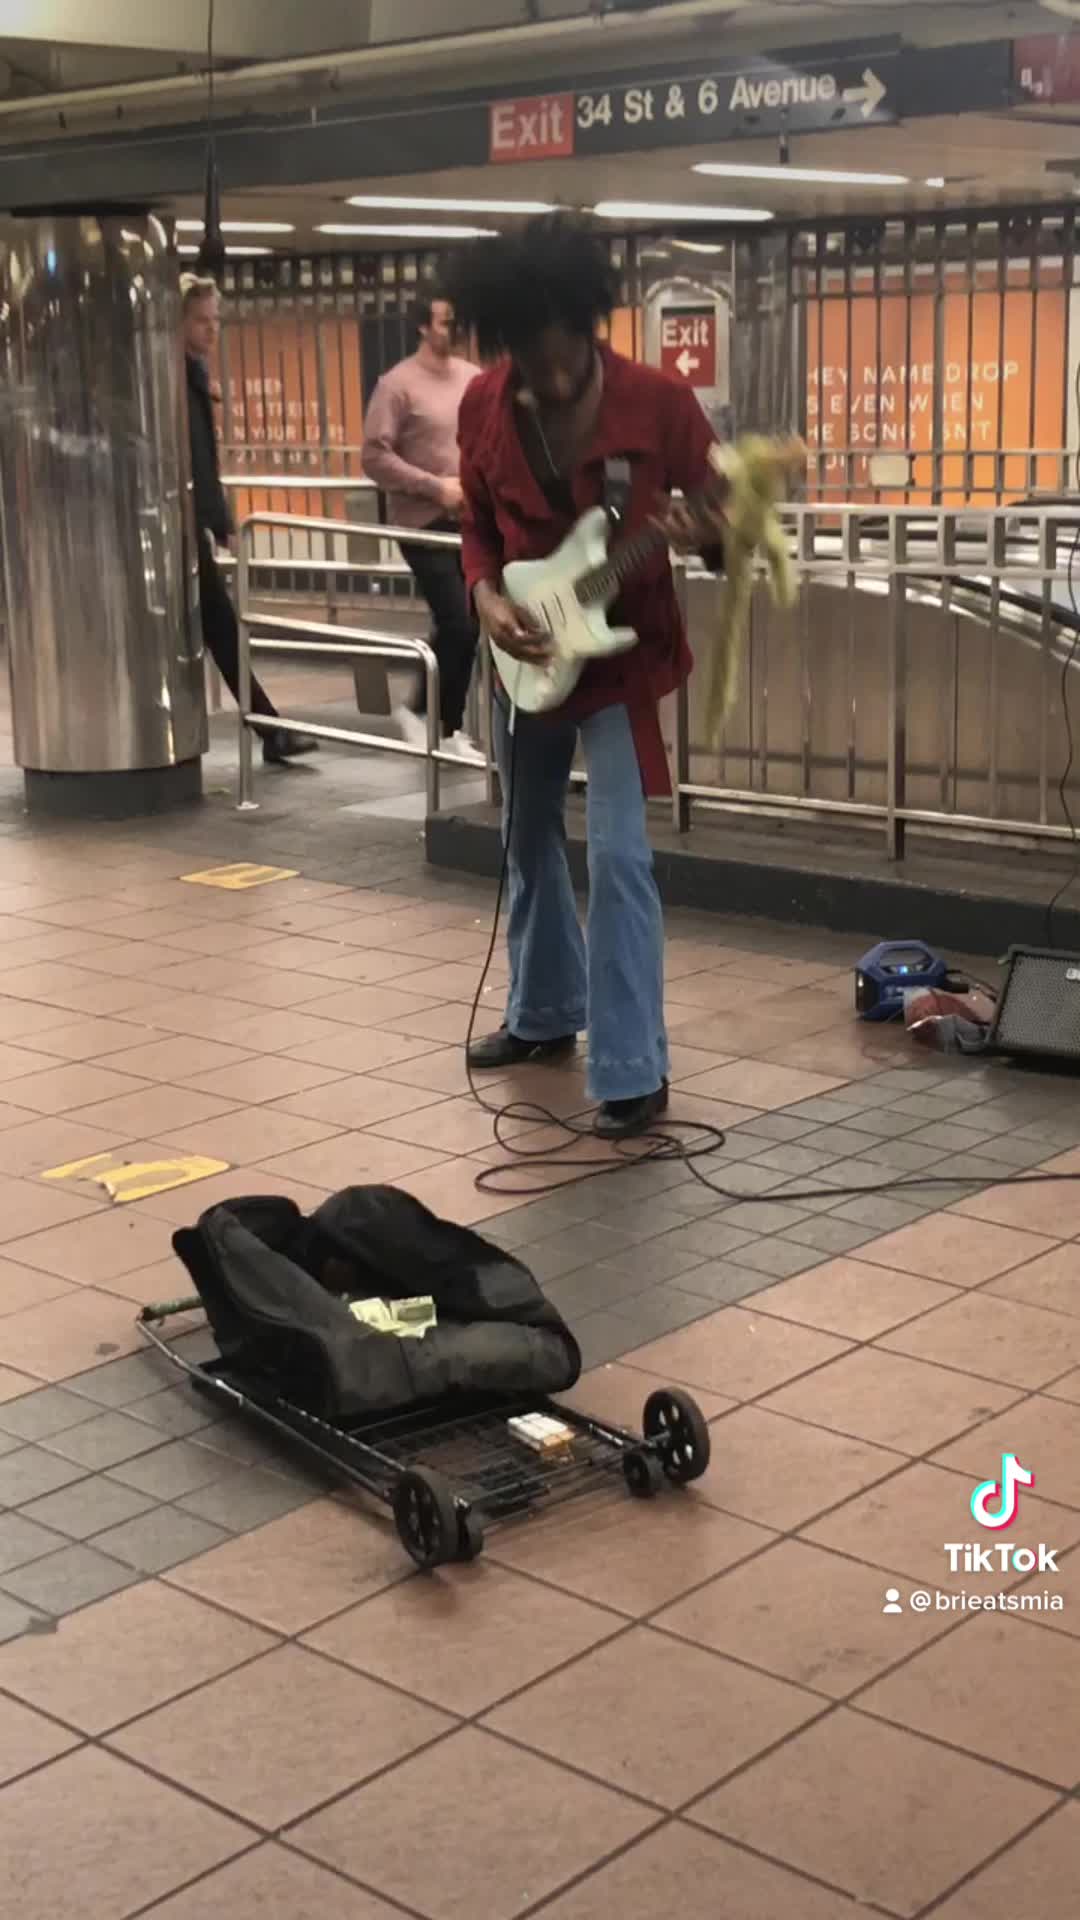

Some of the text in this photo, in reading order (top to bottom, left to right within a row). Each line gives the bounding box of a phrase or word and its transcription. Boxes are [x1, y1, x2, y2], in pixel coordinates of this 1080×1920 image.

[492, 74, 836, 149] Exit 34 St & 6 Avenue
[662, 319, 709, 347] Exit
[863, 362, 934, 385] NAME
[945, 361, 1020, 384] DROP
[831, 394, 896, 414] EVEN
